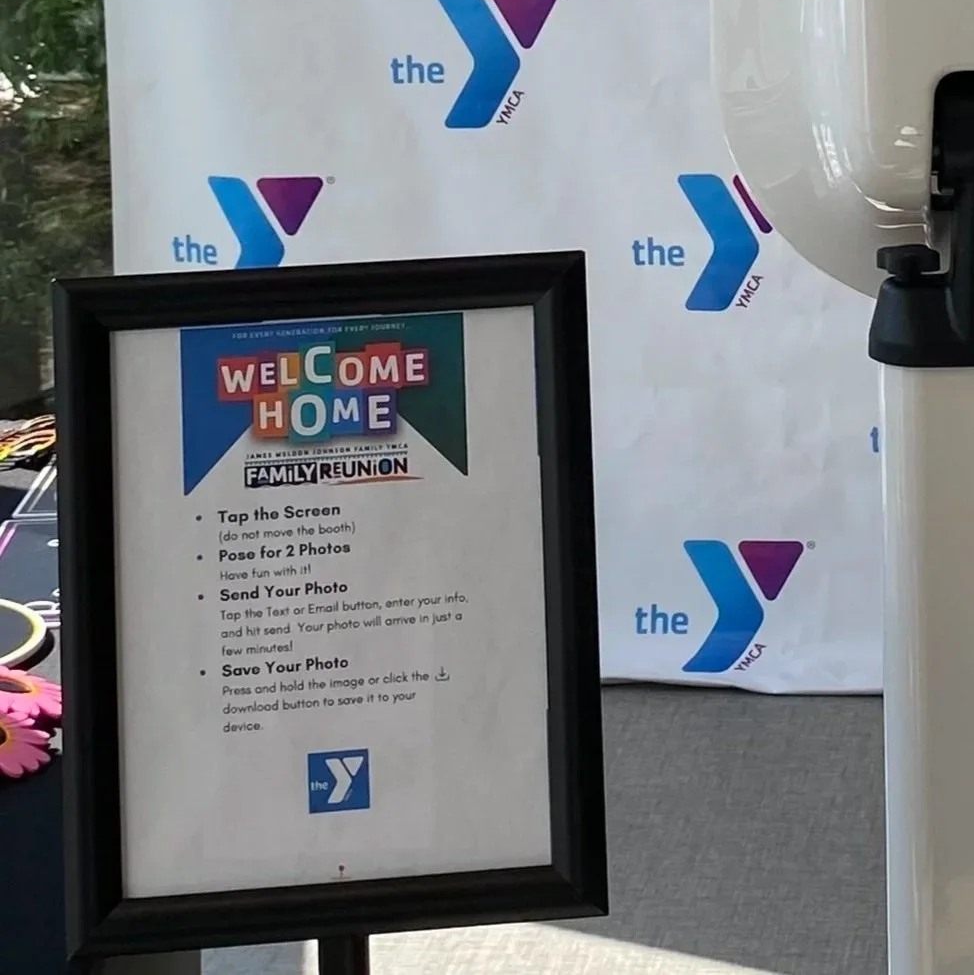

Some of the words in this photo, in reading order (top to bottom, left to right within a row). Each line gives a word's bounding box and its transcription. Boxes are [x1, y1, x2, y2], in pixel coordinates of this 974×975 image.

[391, 55, 444, 84] the
[496, 90, 525, 124] YMCA
[172, 234, 217, 265] the
[632, 237, 684, 266] the
[735, 275, 764, 308] YMCA
[221, 345, 425, 394] WELCOME
[259, 394, 391, 436] HOME
[217, 509, 249, 526] Tap
[254, 506, 279, 521] the
[284, 506, 341, 519] Screen
[219, 530, 238, 544] (do
[241, 530, 260, 540] not
[263, 529, 293, 538] move
[297, 525, 315, 536] the
[318, 521, 356, 534] booth)
[219, 549, 255, 562] Pose
[260, 545, 282, 559] for
[285, 545, 295, 557] 2
[299, 542, 351, 556] Photos
[220, 571, 248, 580] Have
[252, 567, 270, 578] fun
[273, 565, 297, 576] with
[220, 585, 259, 601] Send
[264, 585, 301, 598] Your
[305, 581, 348, 595] Photo
[220, 610, 241, 622] Tap
[245, 608, 263, 618] the
[266, 606, 290, 617] Text
[293, 606, 304, 615] or
[308, 601, 339, 614] Email
[342, 600, 382, 611] button,
[385, 598, 415, 608] enter
[418, 596, 441, 609] your
[635, 604, 688, 634] the
[221, 626, 243, 638] and
[246, 626, 261, 637] hit
[297, 622, 323, 633] Your
[327, 620, 360, 634] photo
[363, 615, 382, 627] will
[385, 616, 416, 626] arrive
[419, 614, 429, 623] in
[432, 612, 451, 625] just
[455, 613, 463, 621] a
[222, 645, 243, 656] few
[246, 640, 293, 655] minutes!
[734, 644, 767, 671] YMCA
[222, 664, 260, 677] Save
[265, 661, 301, 674] Your
[306, 656, 348, 670] Photo
[222, 686, 252, 696] Press
[255, 682, 276, 694] and
[280, 680, 304, 692] hold
[308, 679, 326, 690] the
[329, 678, 365, 690] image
[368, 676, 380, 685] or
[382, 671, 408, 684] click
[411, 670, 430, 681] the
[222, 699, 279, 714] download
[282, 699, 320, 710] button
[323, 698, 335, 706] to
[337, 696, 363, 706] save
[367, 694, 374, 703] it
[378, 693, 389, 702] to
[392, 692, 416, 704] your
[311, 780, 328, 791] the
